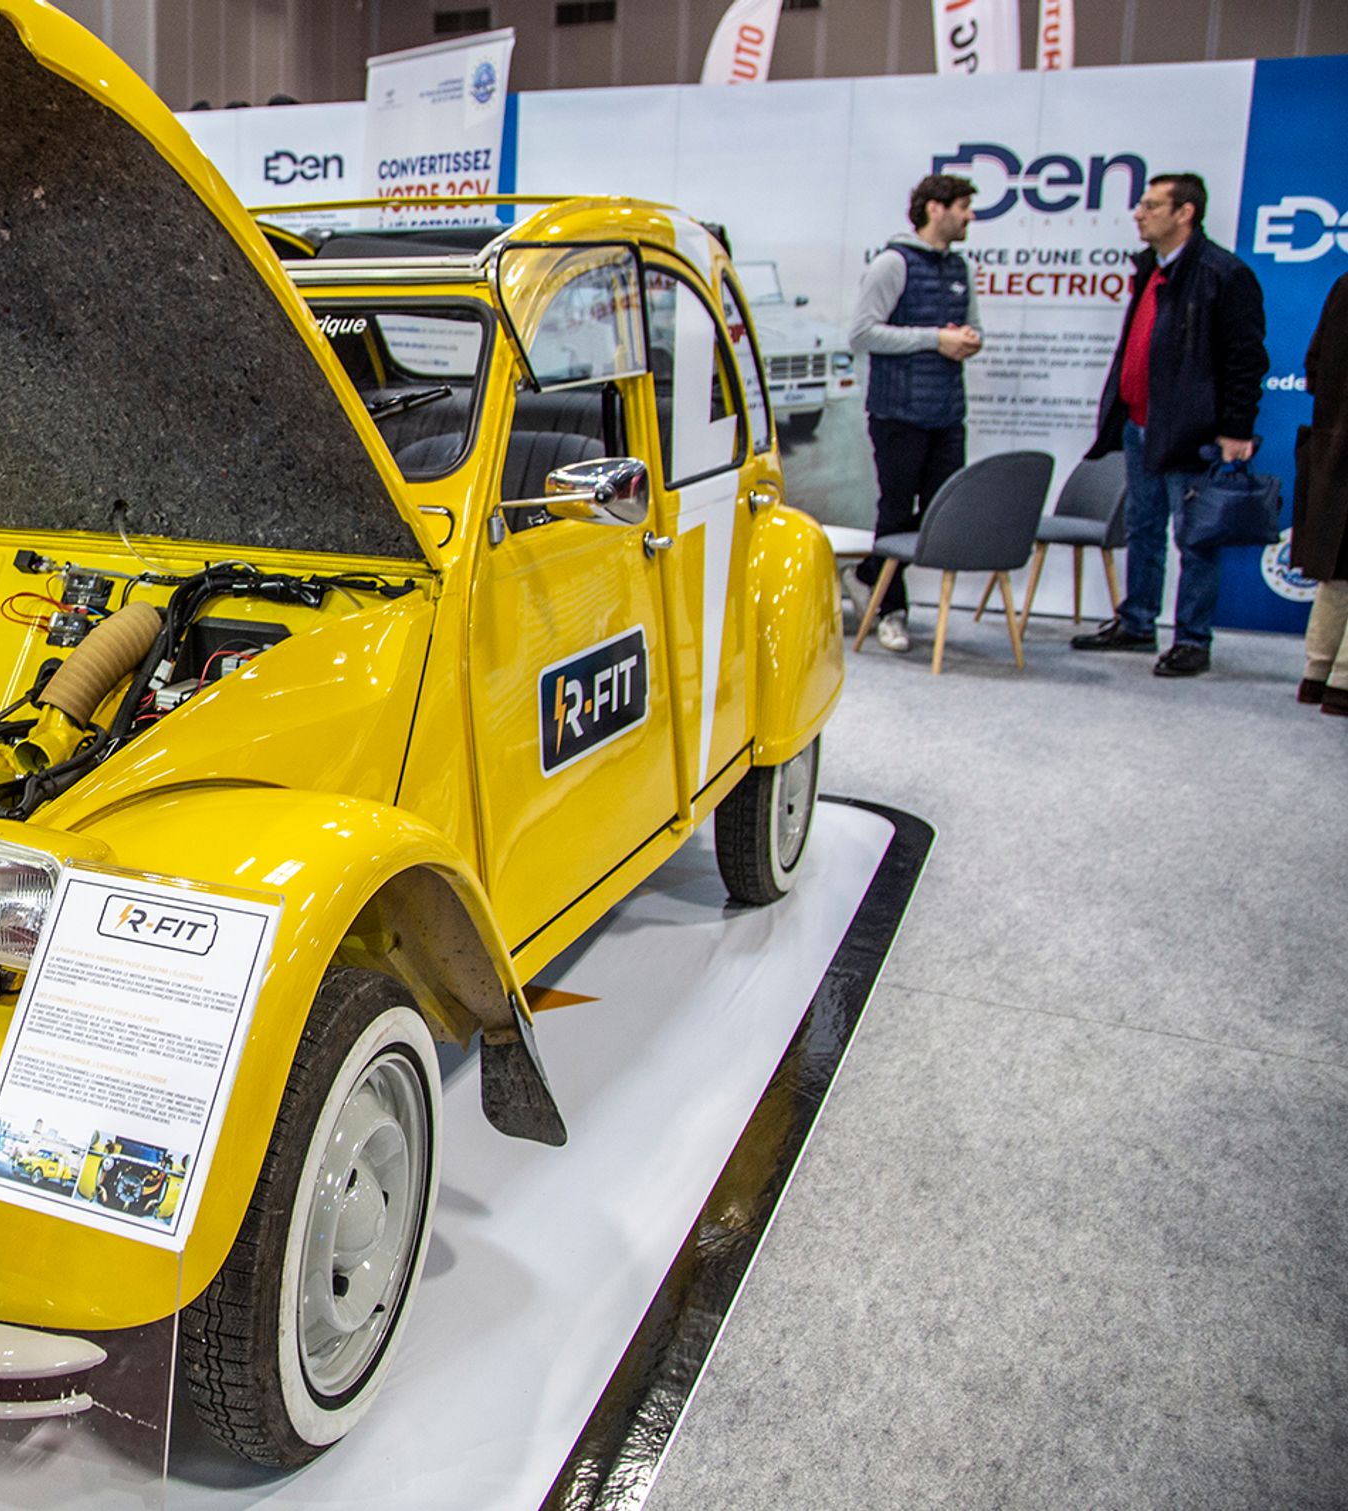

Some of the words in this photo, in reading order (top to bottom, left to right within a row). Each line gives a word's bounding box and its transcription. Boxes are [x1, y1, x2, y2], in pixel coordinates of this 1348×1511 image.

[726, 24, 764, 84] UTO
[378, 148, 492, 180] CONVERTISSEZ
[378, 182, 440, 214] VOTRE
[445, 178, 491, 210] 2CV
[1016, 247, 1082, 265] D'UNE
[564, 654, 638, 738] R-FIT
[128, 908, 208, 941] R-FIT
